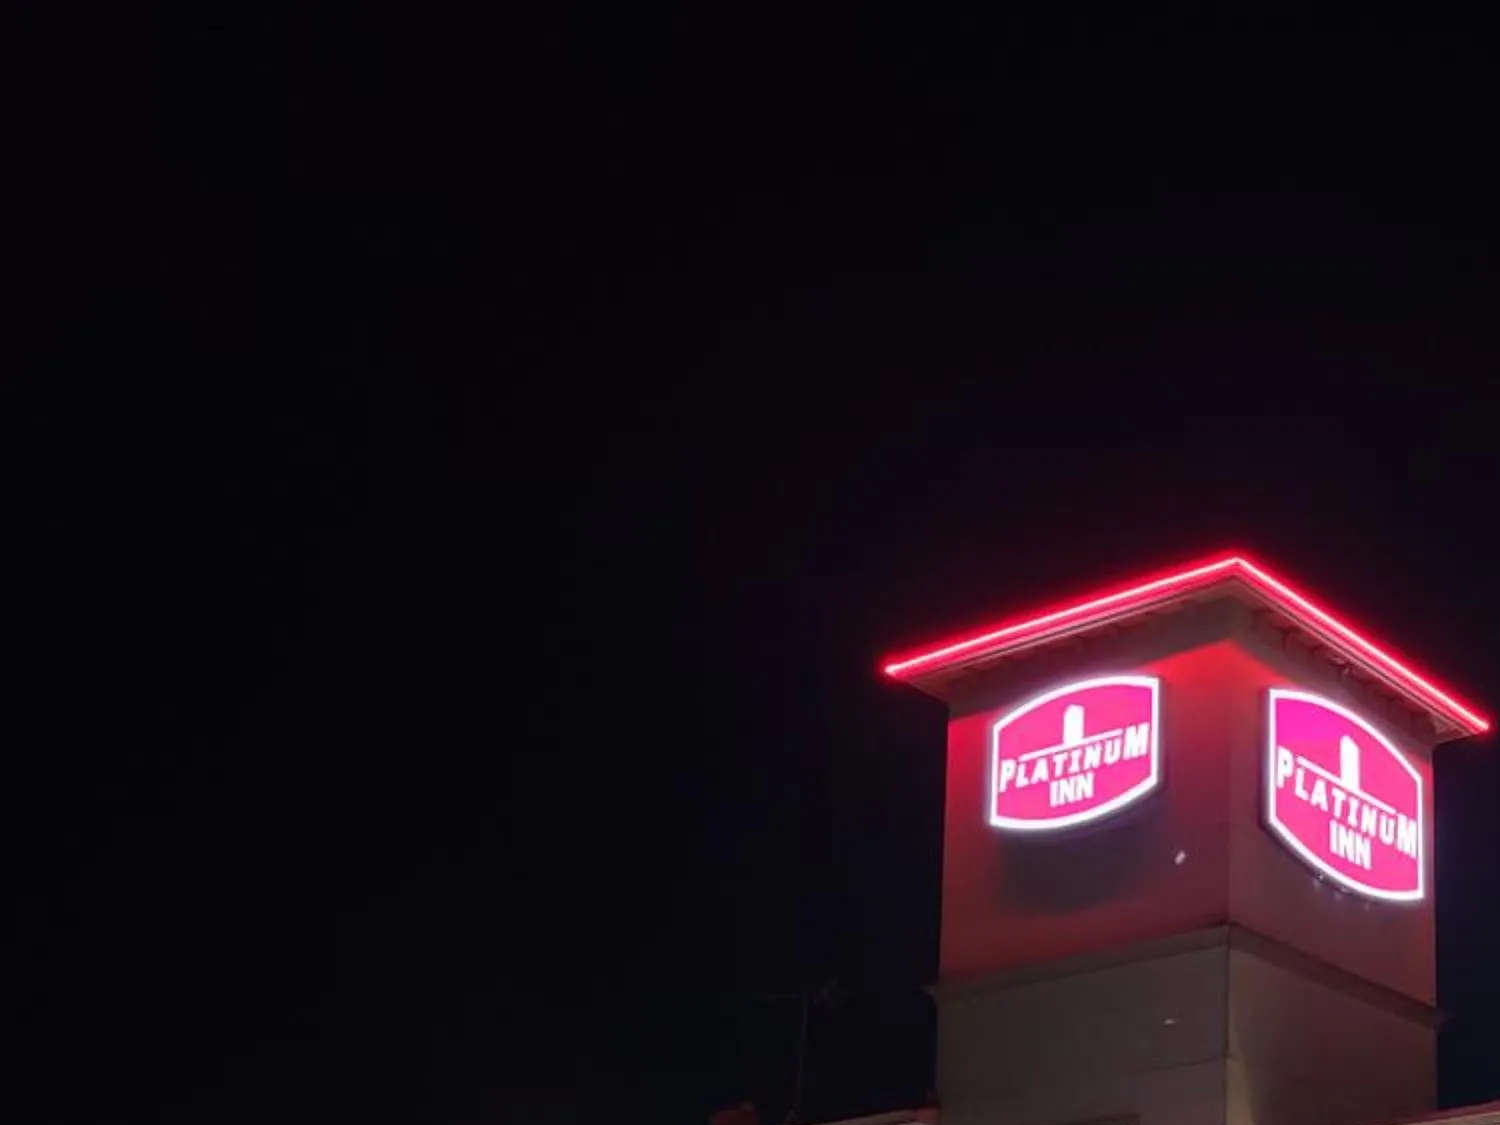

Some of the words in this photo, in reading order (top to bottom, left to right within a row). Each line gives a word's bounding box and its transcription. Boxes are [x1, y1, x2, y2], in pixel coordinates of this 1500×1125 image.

[999, 722, 1150, 793] PLATINUM
[1049, 772, 1095, 807] INN
[1276, 745, 1418, 860] PLATINUM
[1329, 819, 1372, 871] INN
